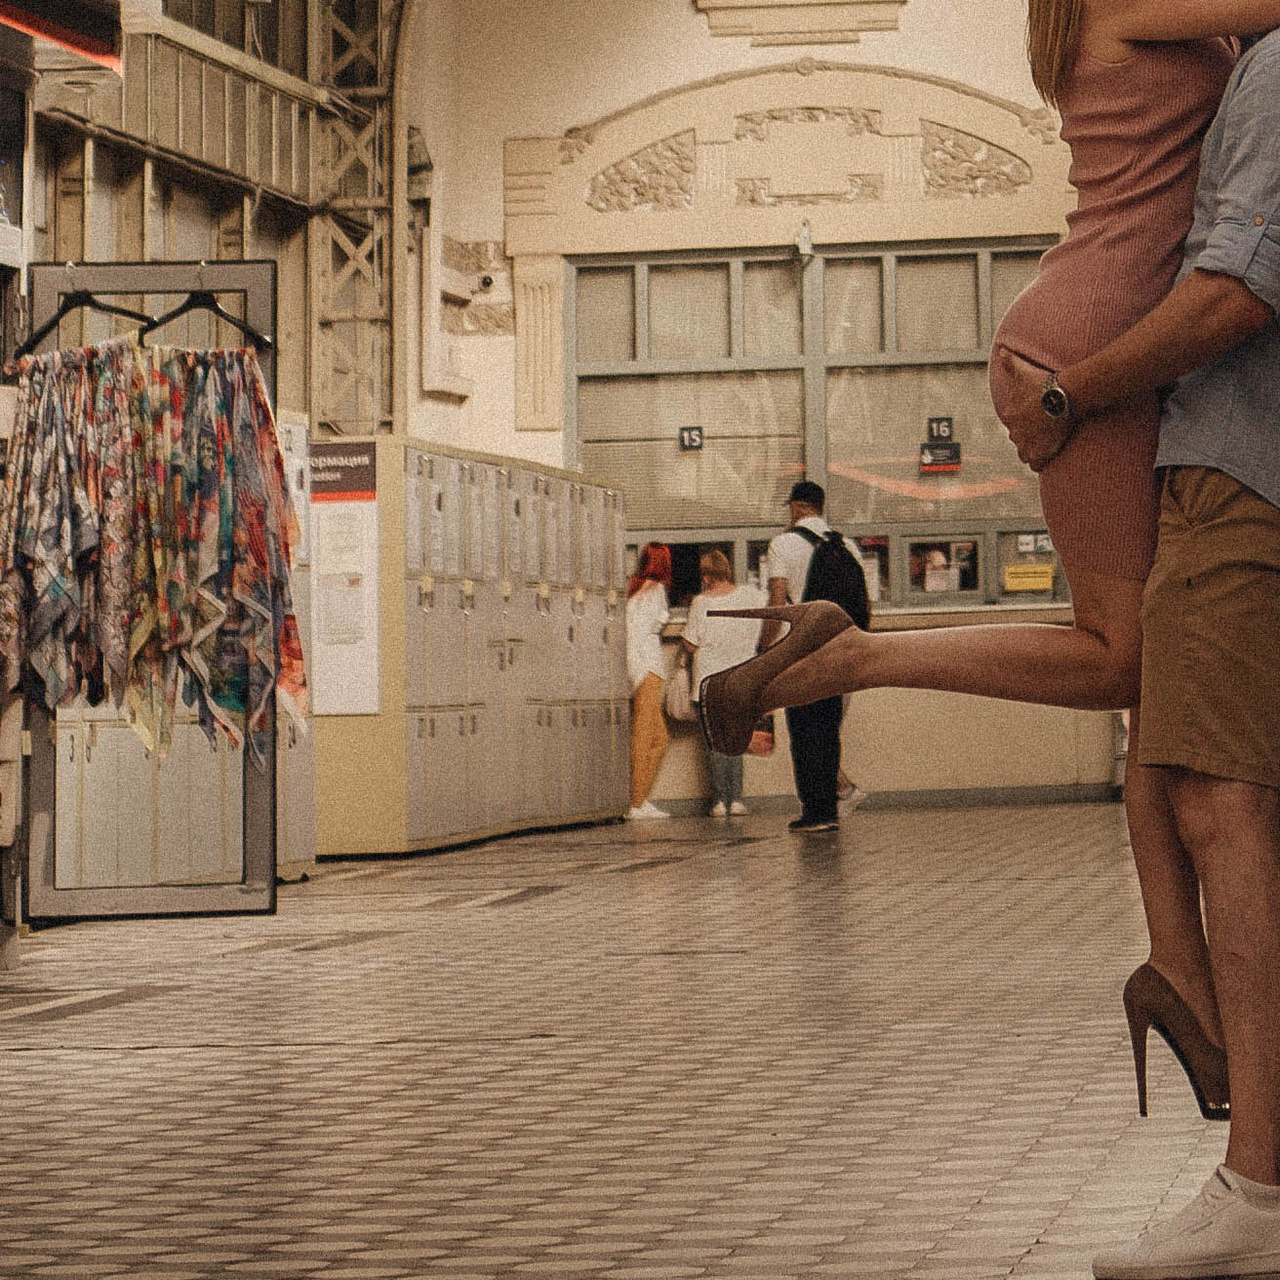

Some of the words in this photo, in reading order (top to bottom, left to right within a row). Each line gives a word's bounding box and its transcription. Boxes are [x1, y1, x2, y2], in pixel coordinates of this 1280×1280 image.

[932, 421, 950, 437] 16
[682, 430, 701, 448] 15
[311, 455, 369, 470] ормация
